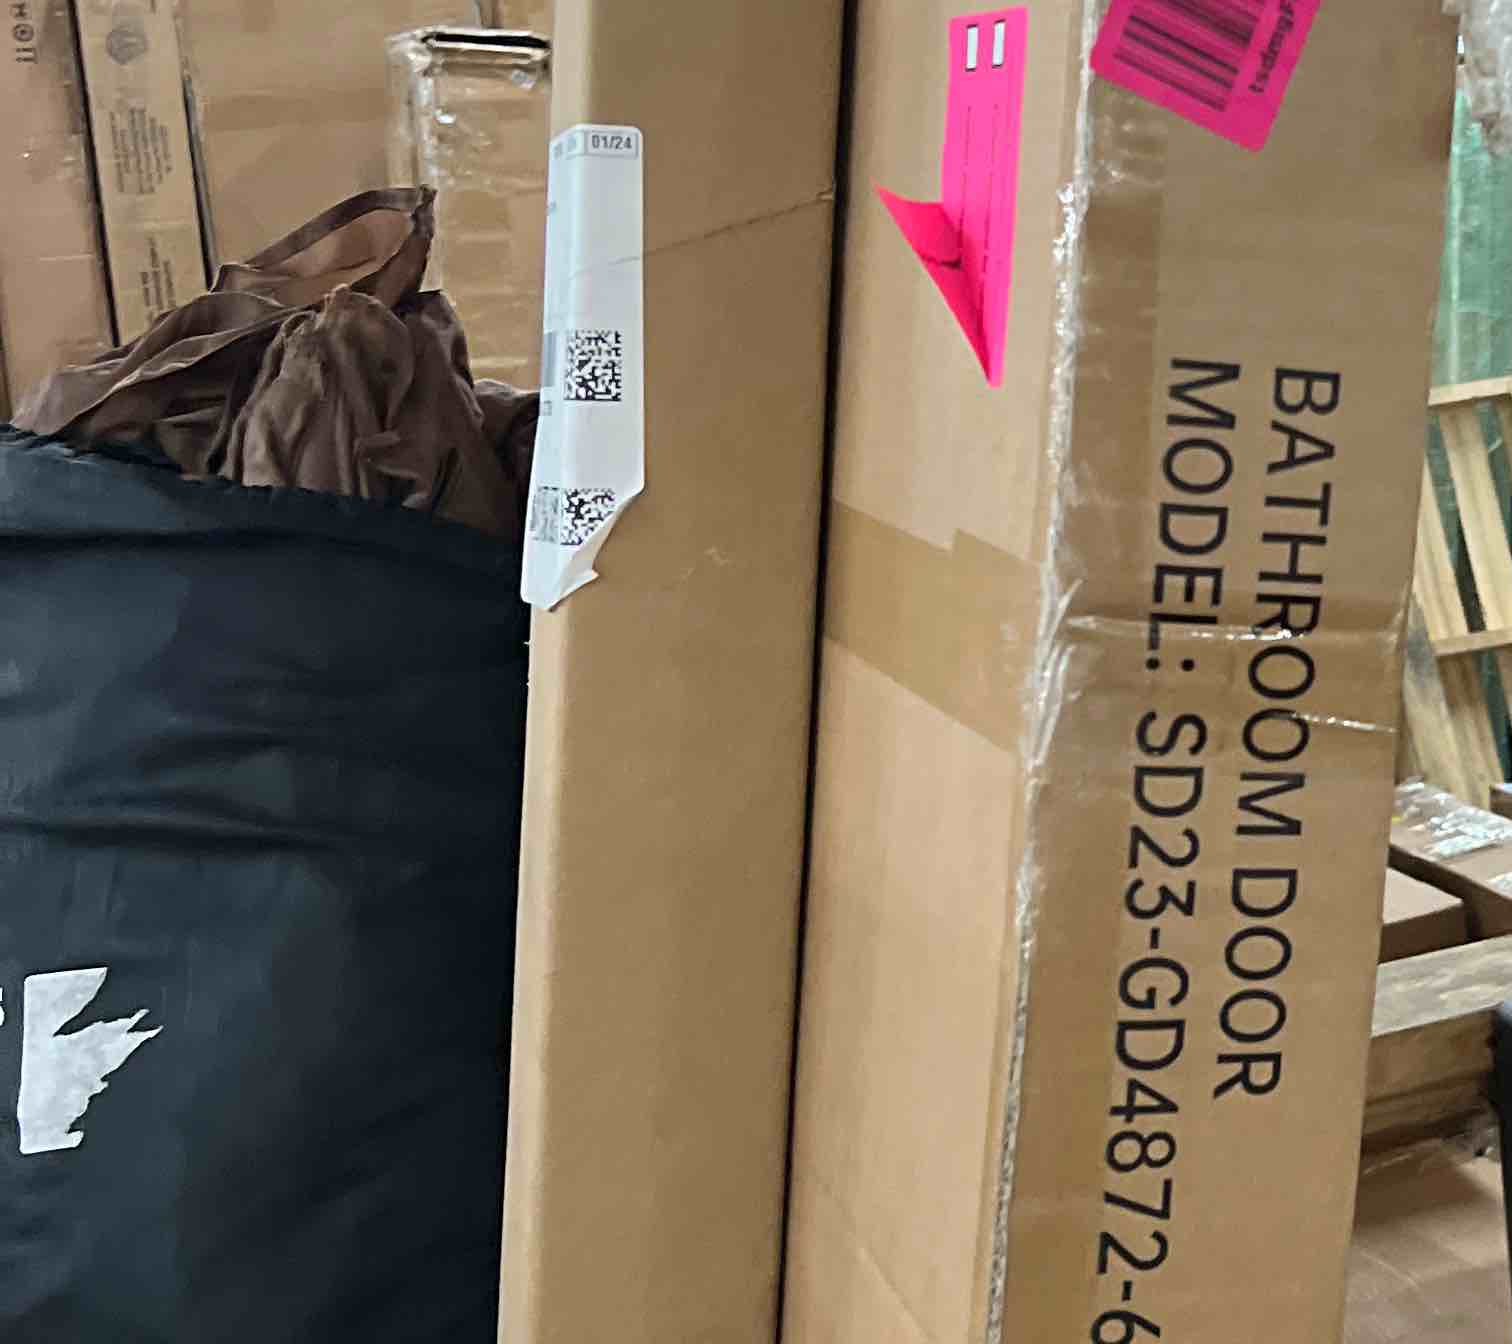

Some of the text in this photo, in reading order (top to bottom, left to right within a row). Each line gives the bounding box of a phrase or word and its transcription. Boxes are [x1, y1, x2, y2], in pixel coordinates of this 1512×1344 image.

[591, 134, 633, 150] 01/24
[1145, 355, 1242, 675] MODEL:
[1212, 363, 1341, 1100] BATHROOM DOOR
